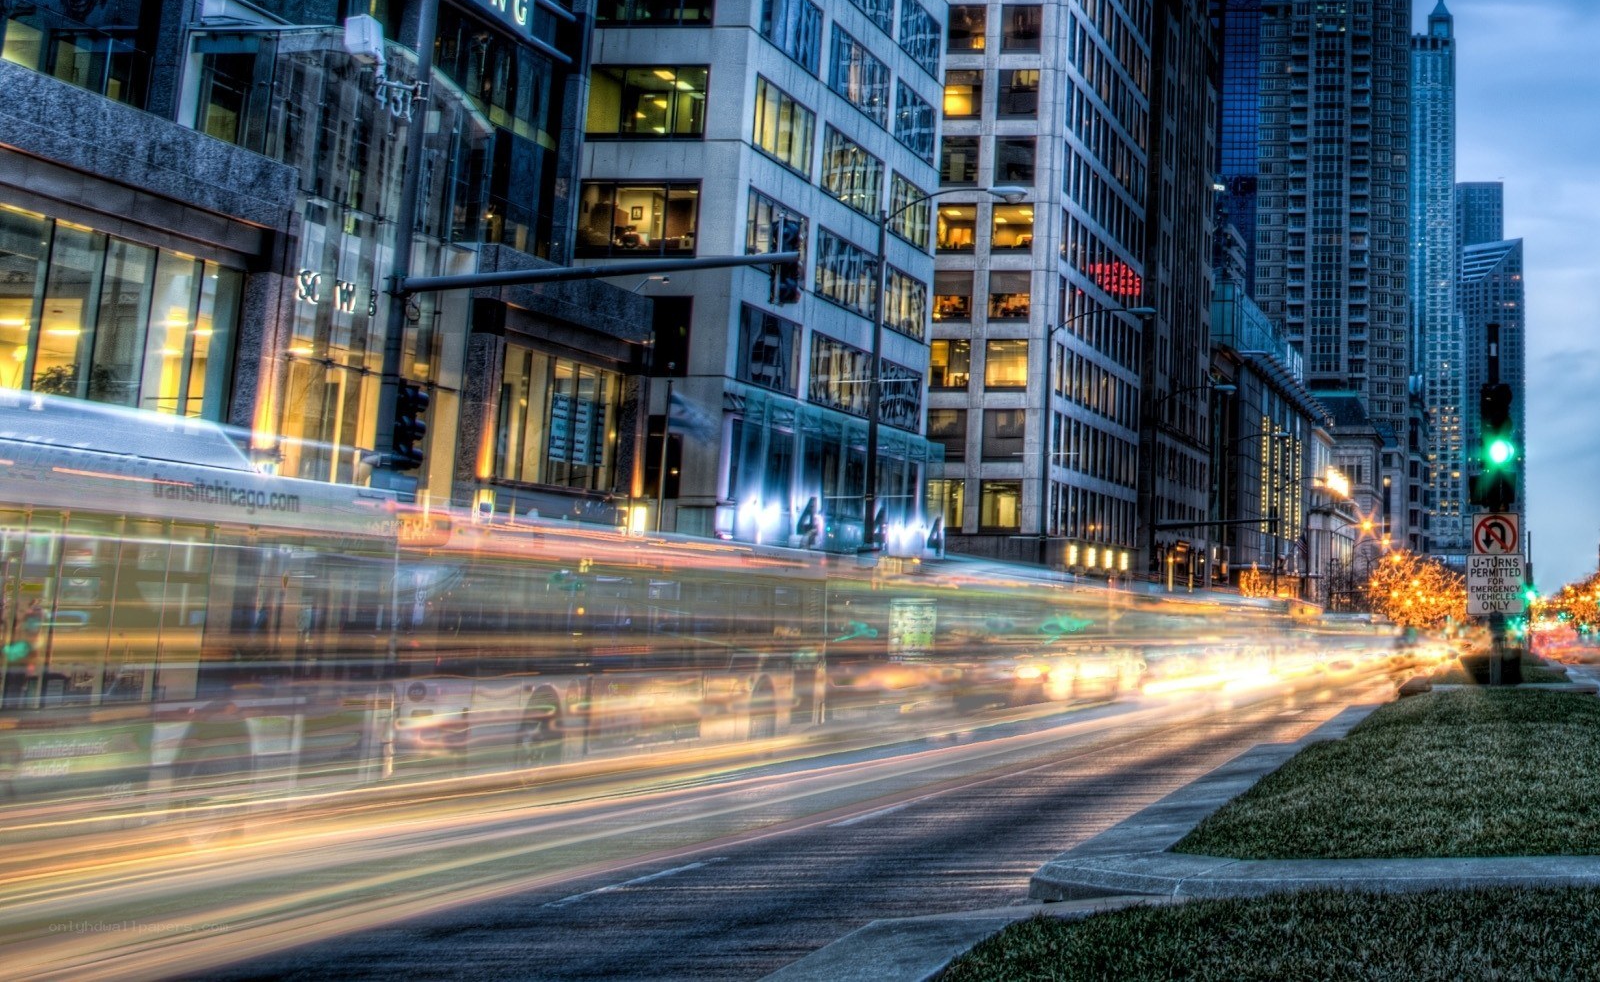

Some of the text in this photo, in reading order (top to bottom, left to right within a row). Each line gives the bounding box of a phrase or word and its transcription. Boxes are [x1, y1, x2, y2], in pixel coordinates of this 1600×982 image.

[294, 269, 377, 317] SCWB
[153, 473, 300, 514] transitchicago.com
[1472, 558, 1519, 567] U-TURNS
[1470, 568, 1521, 577] PERMITTED
[1470, 585, 1521, 593] EMERGENCY
[1476, 593, 1517, 601] VEHICLES
[1482, 601, 1510, 610] ONLY
